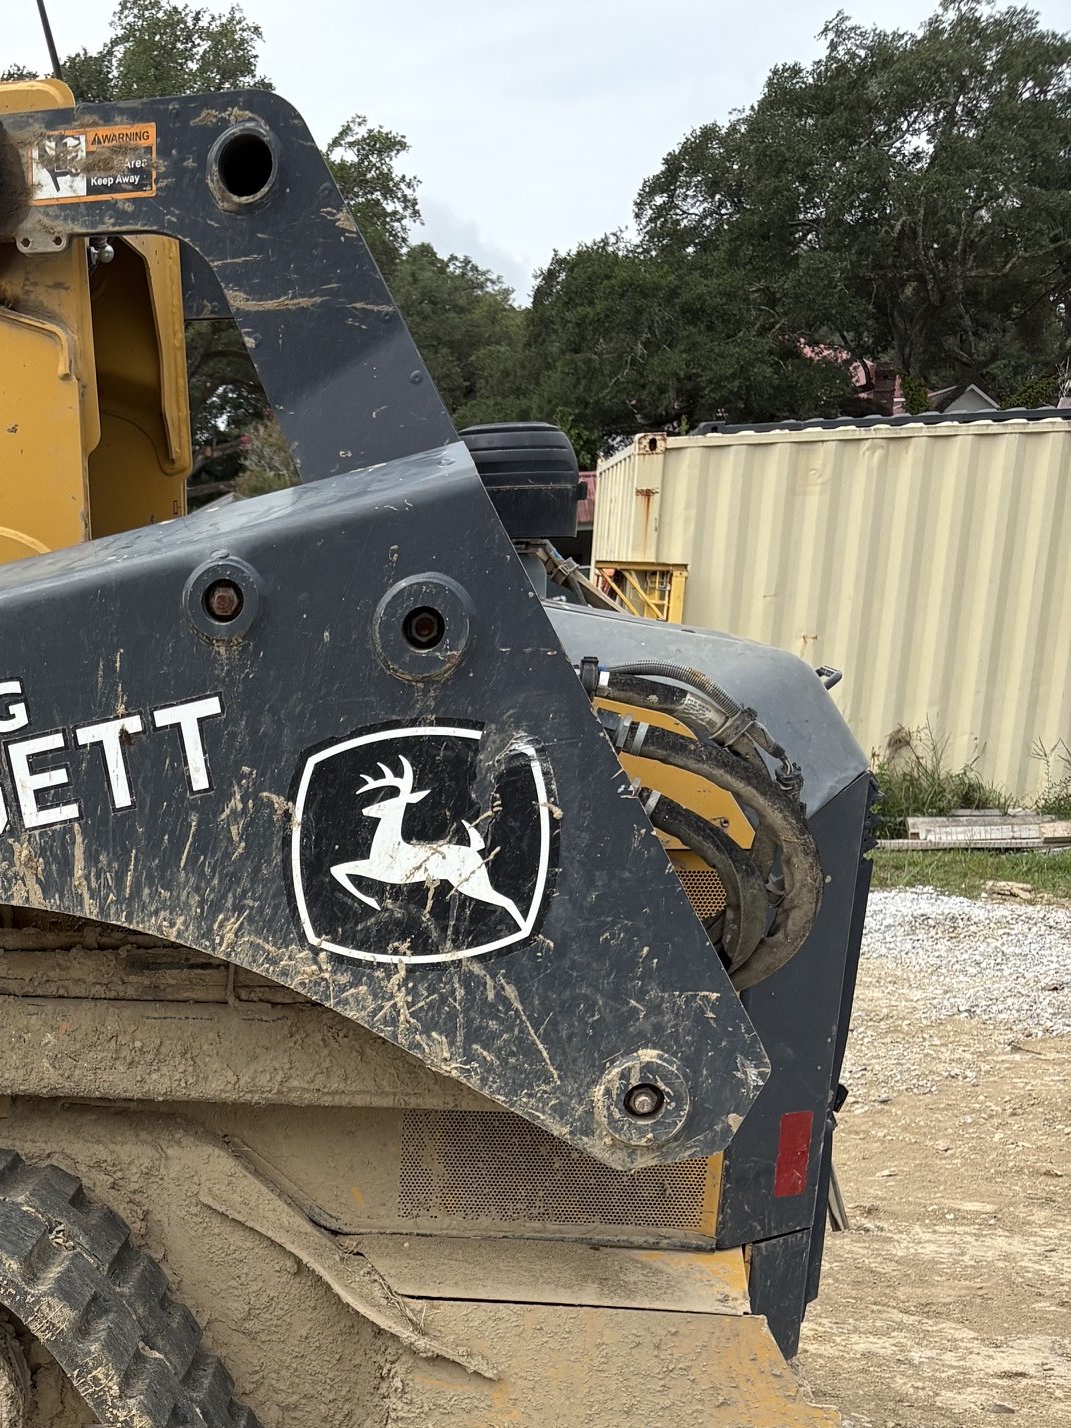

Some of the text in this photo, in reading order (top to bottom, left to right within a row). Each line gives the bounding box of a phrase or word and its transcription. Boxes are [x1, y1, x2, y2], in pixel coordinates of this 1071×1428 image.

[101, 131, 150, 144] WARNING
[91, 174, 140, 187] Keep Away
